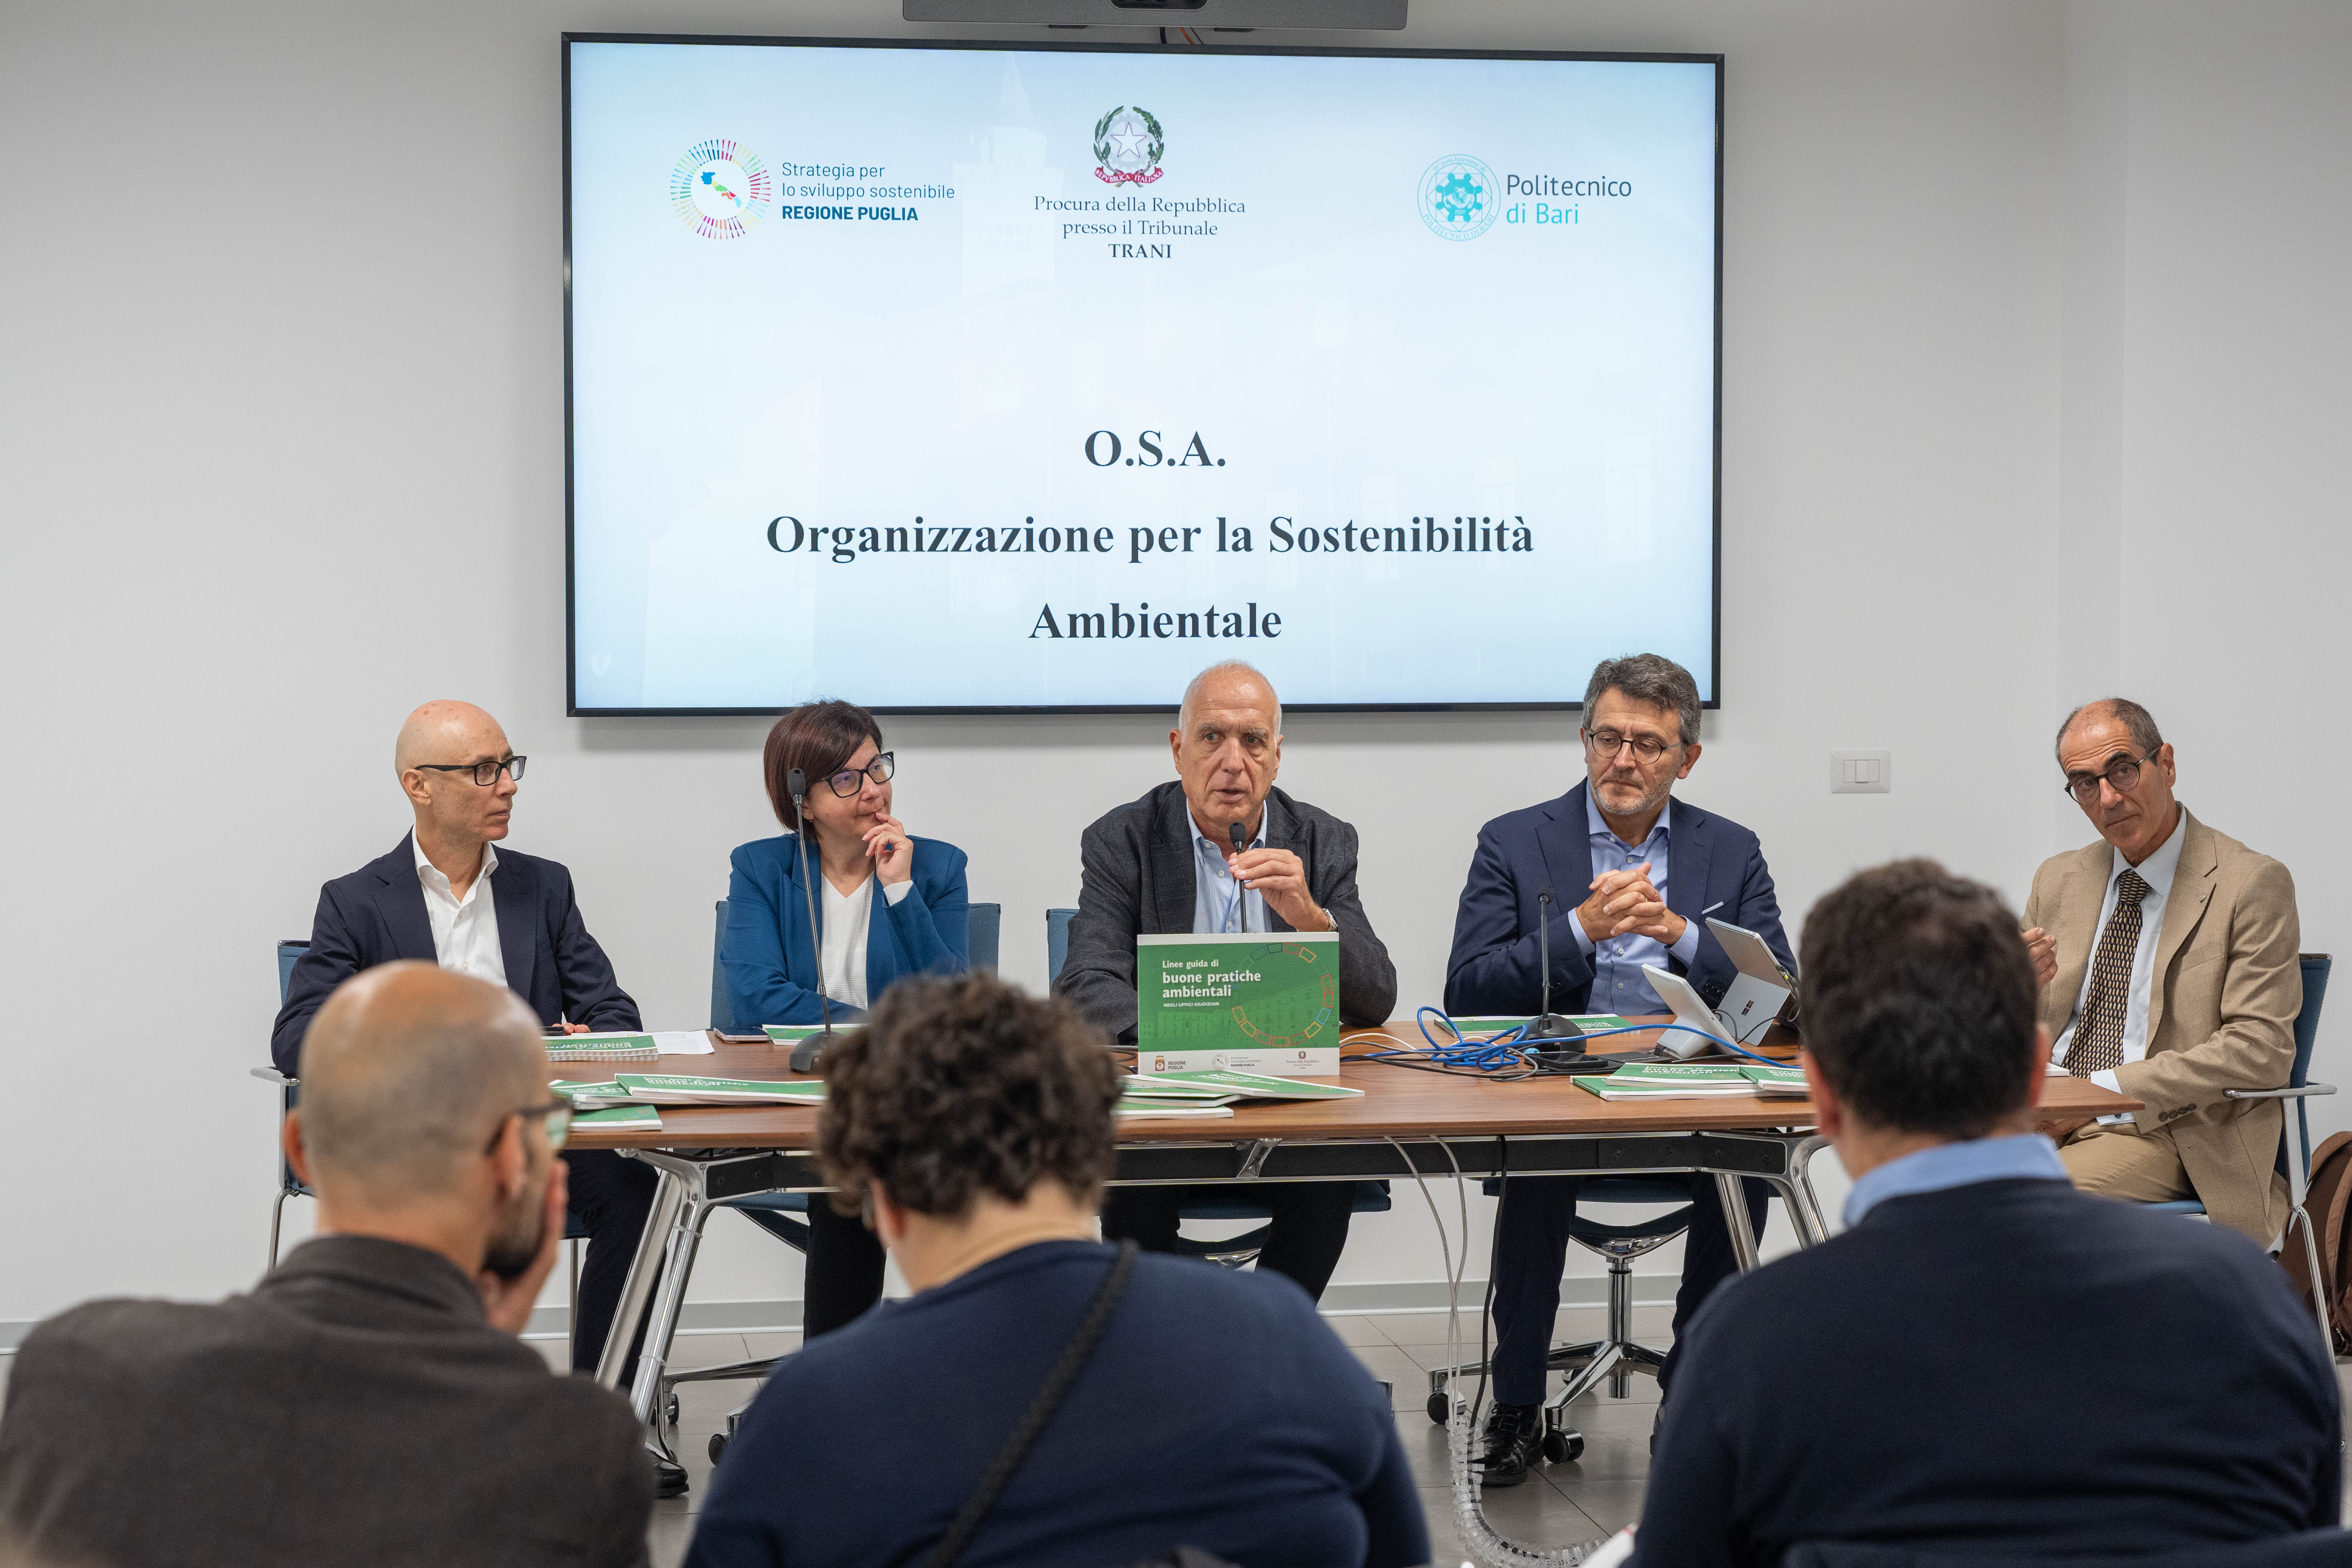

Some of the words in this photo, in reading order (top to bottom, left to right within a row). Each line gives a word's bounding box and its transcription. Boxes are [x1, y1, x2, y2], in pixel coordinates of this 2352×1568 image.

[782, 162, 855, 180] Strategia
[859, 167, 886, 181] per
[1134, 171, 1163, 182] ITALIANA
[782, 182, 796, 196] lo
[800, 182, 865, 201] sviluppo
[869, 184, 955, 199] sostenibile
[1507, 174, 1632, 197] Politecnico
[782, 205, 854, 220] REGIONE
[858, 206, 919, 221] PUGLIA
[1034, 196, 1101, 211] Procura
[1105, 196, 1146, 212] della
[1152, 197, 1246, 217] Repubblica
[1506, 203, 1526, 224] di
[1536, 202, 1579, 224] Bari
[1063, 223, 1117, 239] presso
[1122, 220, 1132, 234] il
[1137, 220, 1218, 235] Tribunale
[1424, 213, 1469, 240] POLITECNICO
[1471, 228, 1480, 237] DI
[1480, 214, 1494, 232] BARI
[1108, 243, 1172, 258] TRANI
[1084, 429, 1227, 468] O.S.A.
[766, 515, 1115, 564] Organizzazione
[1128, 526, 1202, 564] per
[1216, 516, 1255, 553] la
[1269, 515, 1535, 554] Sostenibilità
[1027, 601, 1283, 640] Ambientale
[1162, 960, 1183, 969] Linee
[1186, 959, 1208, 970] guida
[1211, 959, 1219, 967] di
[1163, 972, 1203, 984] buone
[1207, 970, 1261, 986] pratiche
[1162, 984, 1231, 998] ambientali
